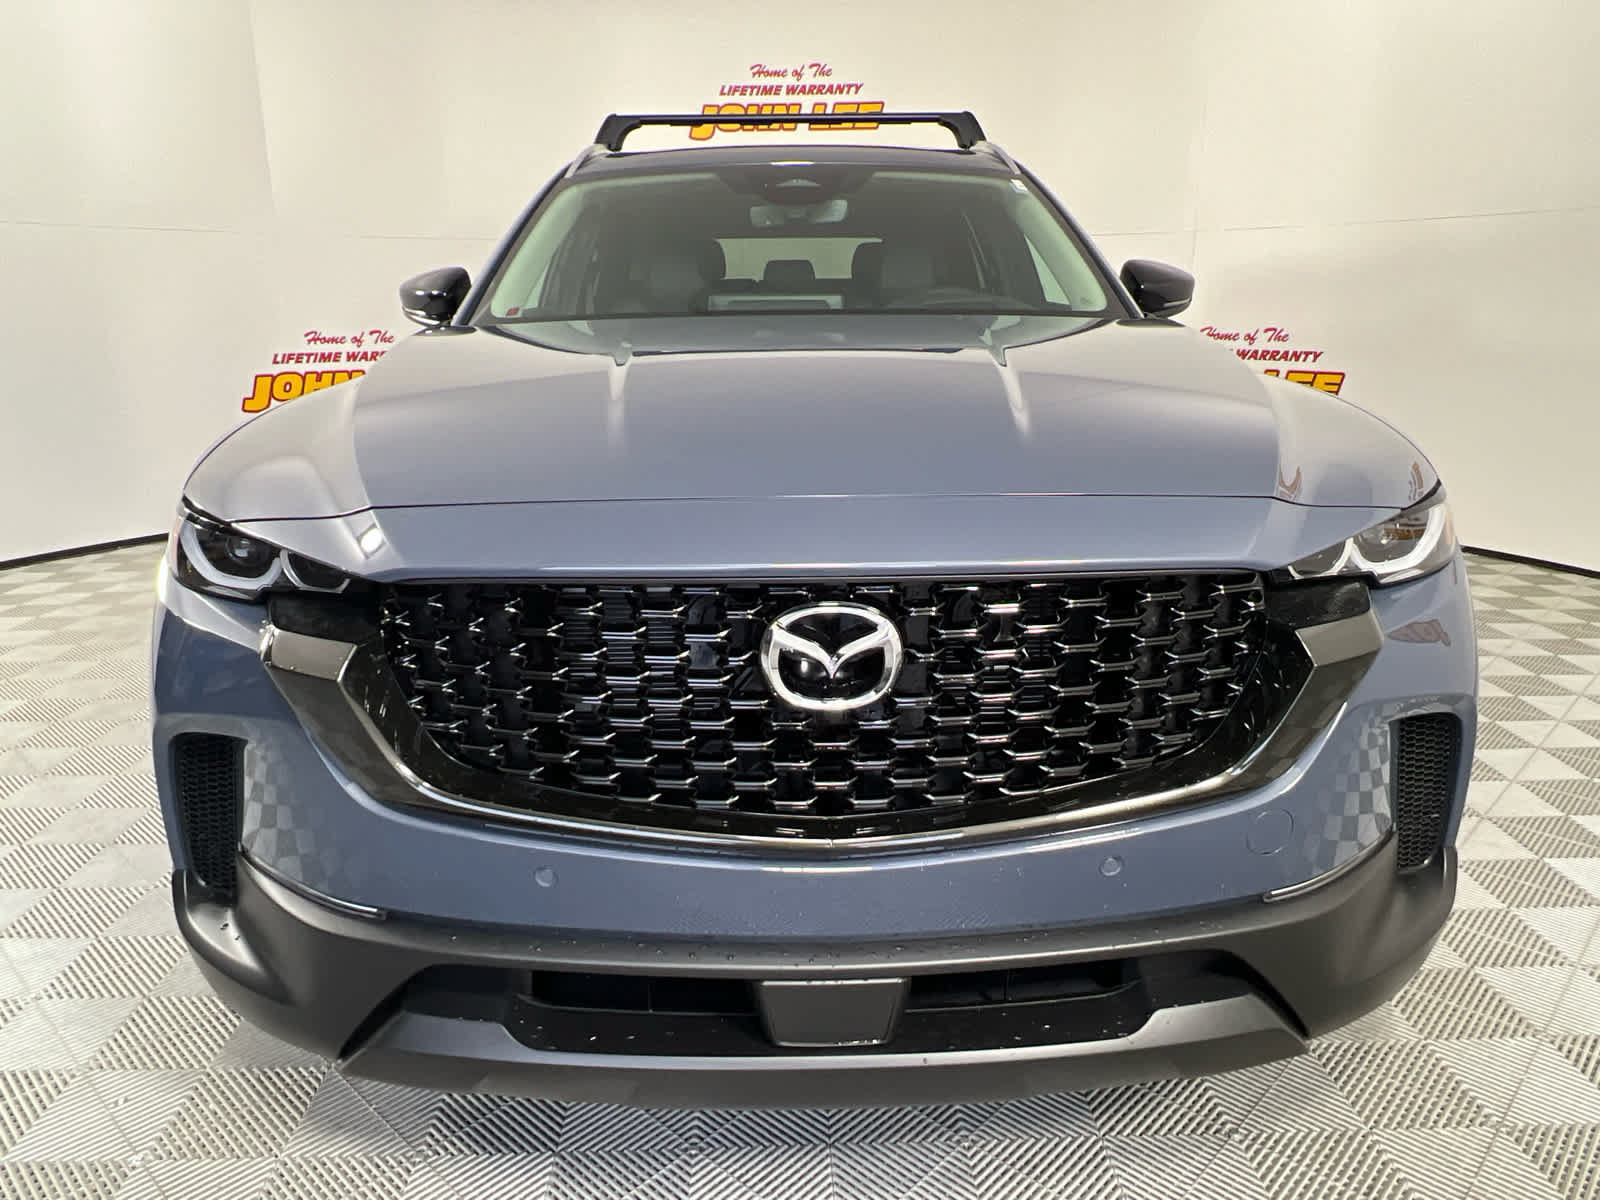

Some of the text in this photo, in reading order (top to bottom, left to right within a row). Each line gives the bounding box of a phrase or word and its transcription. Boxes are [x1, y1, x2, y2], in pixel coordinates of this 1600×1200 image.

[749, 63, 833, 81] Home of The
[719, 82, 864, 97] LIFETIME WARRANTY
[689, 103, 802, 141] JOHN
[304, 329, 395, 347] Home of The
[1243, 328, 1260, 345] of
[1263, 327, 1289, 343] The
[272, 351, 342, 365] LIFETIME
[1236, 348, 1324, 363] WARRANTY
